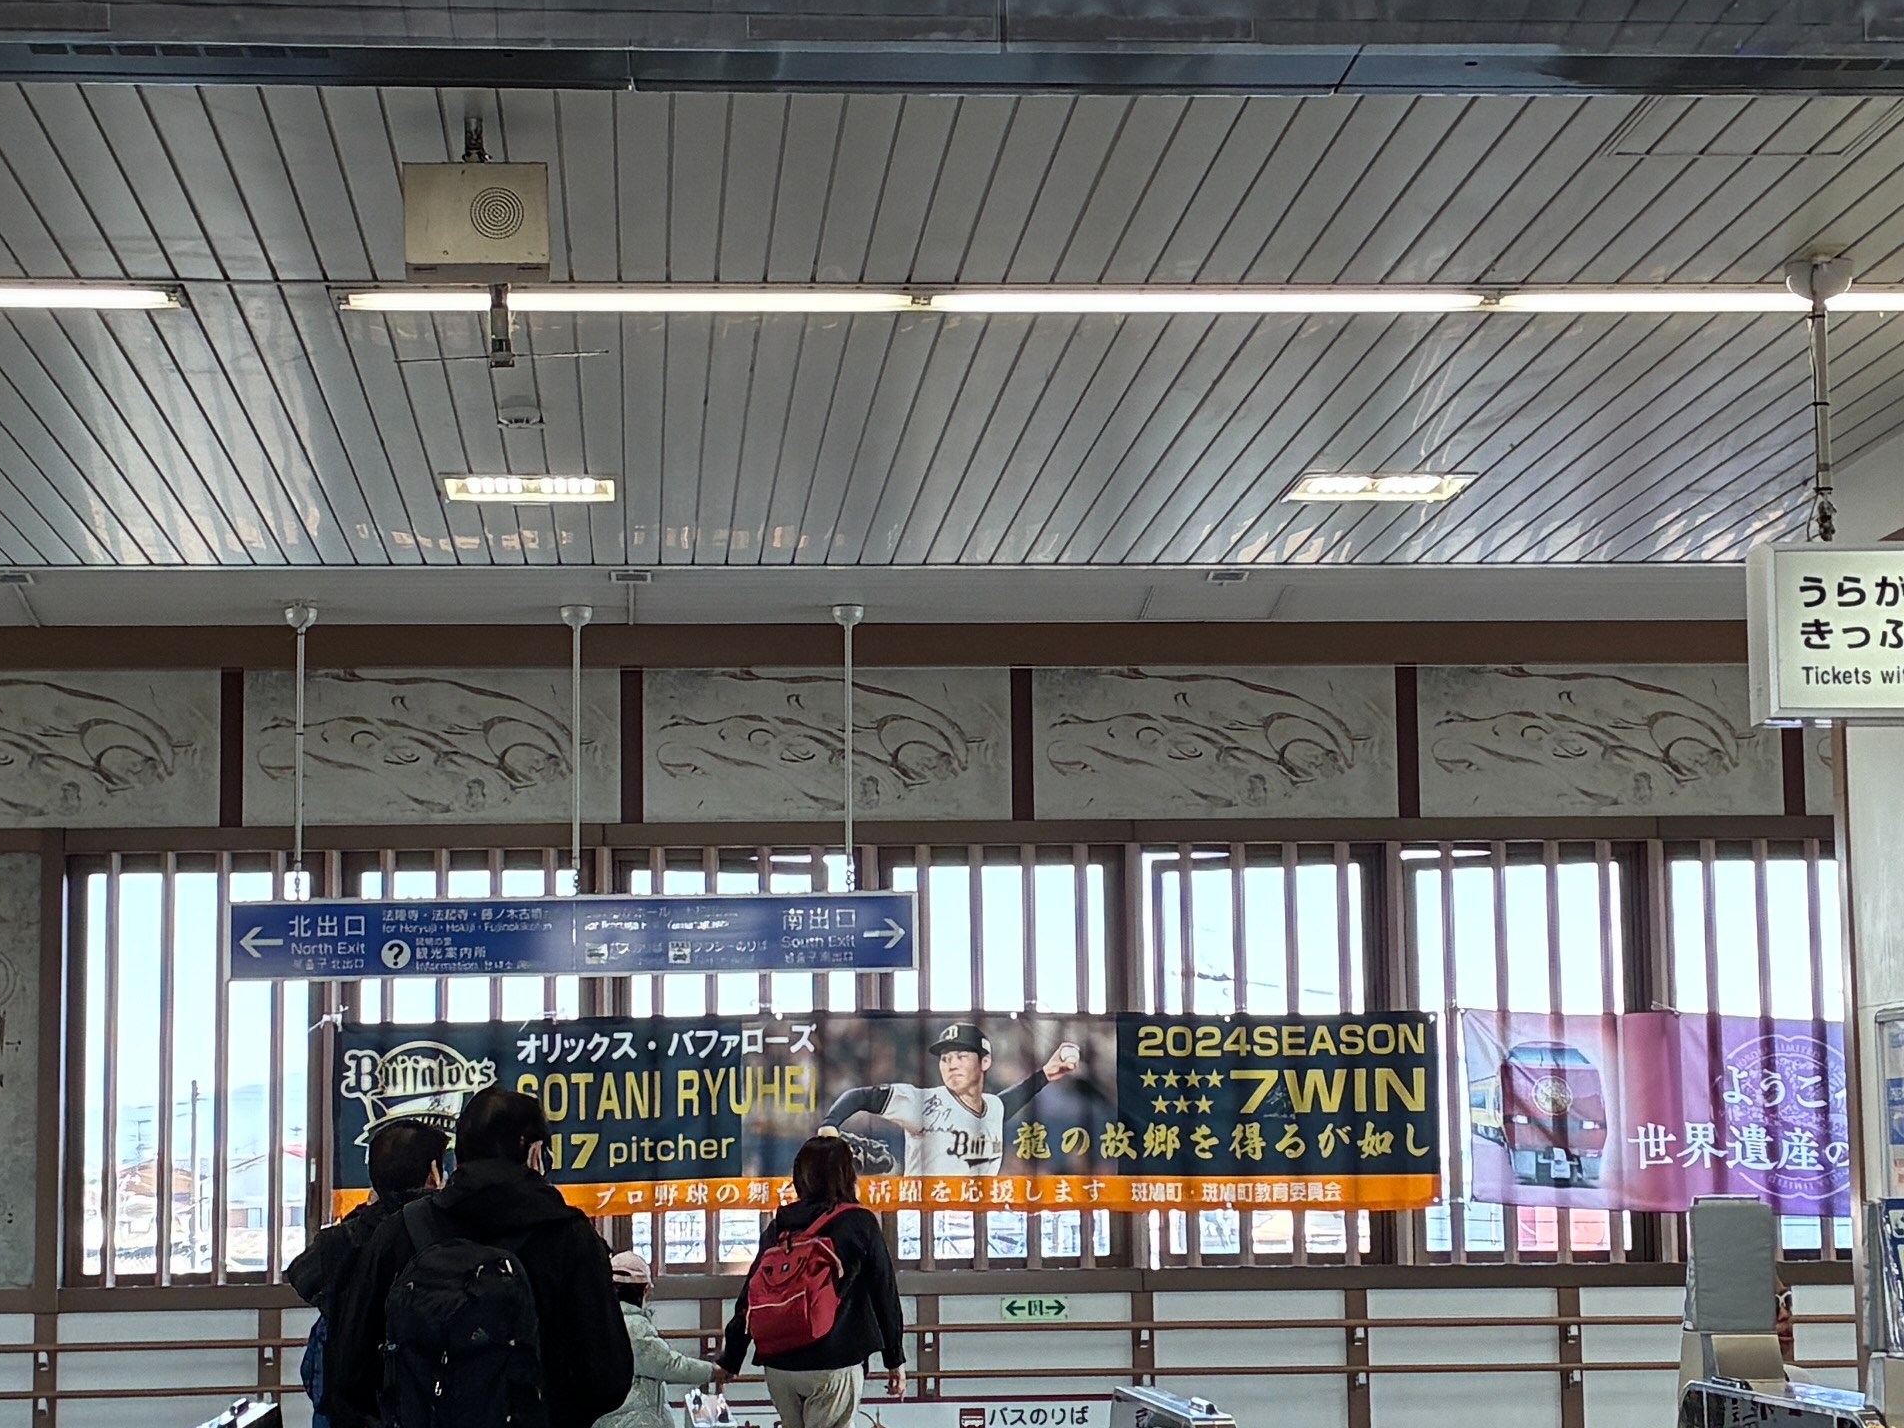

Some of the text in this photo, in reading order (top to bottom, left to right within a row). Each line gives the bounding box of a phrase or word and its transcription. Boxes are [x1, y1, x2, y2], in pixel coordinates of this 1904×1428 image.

[1802, 666, 1871, 684] Tickets
[289, 915, 366, 937] 北出口
[782, 908, 856, 930] 南出口
[291, 942, 365, 954] North Exit
[781, 936, 856, 948] South Exit
[516, 1025, 817, 1064] オリックス・バファローズ
[1138, 1024, 1425, 1057] 2024SEASON
[341, 1049, 497, 1098] Buffaloes
[516, 1067, 817, 1121] SOTANI RYUHEI
[1229, 1067, 1425, 1114] 7WIN
[609, 1135, 735, 1167] pitcher
[1014, 1121, 1430, 1161] 龍の故郷を得るが如し
[1628, 1121, 1849, 1172] 世界遺産の
[989, 1406, 1088, 1425] バスのりば
